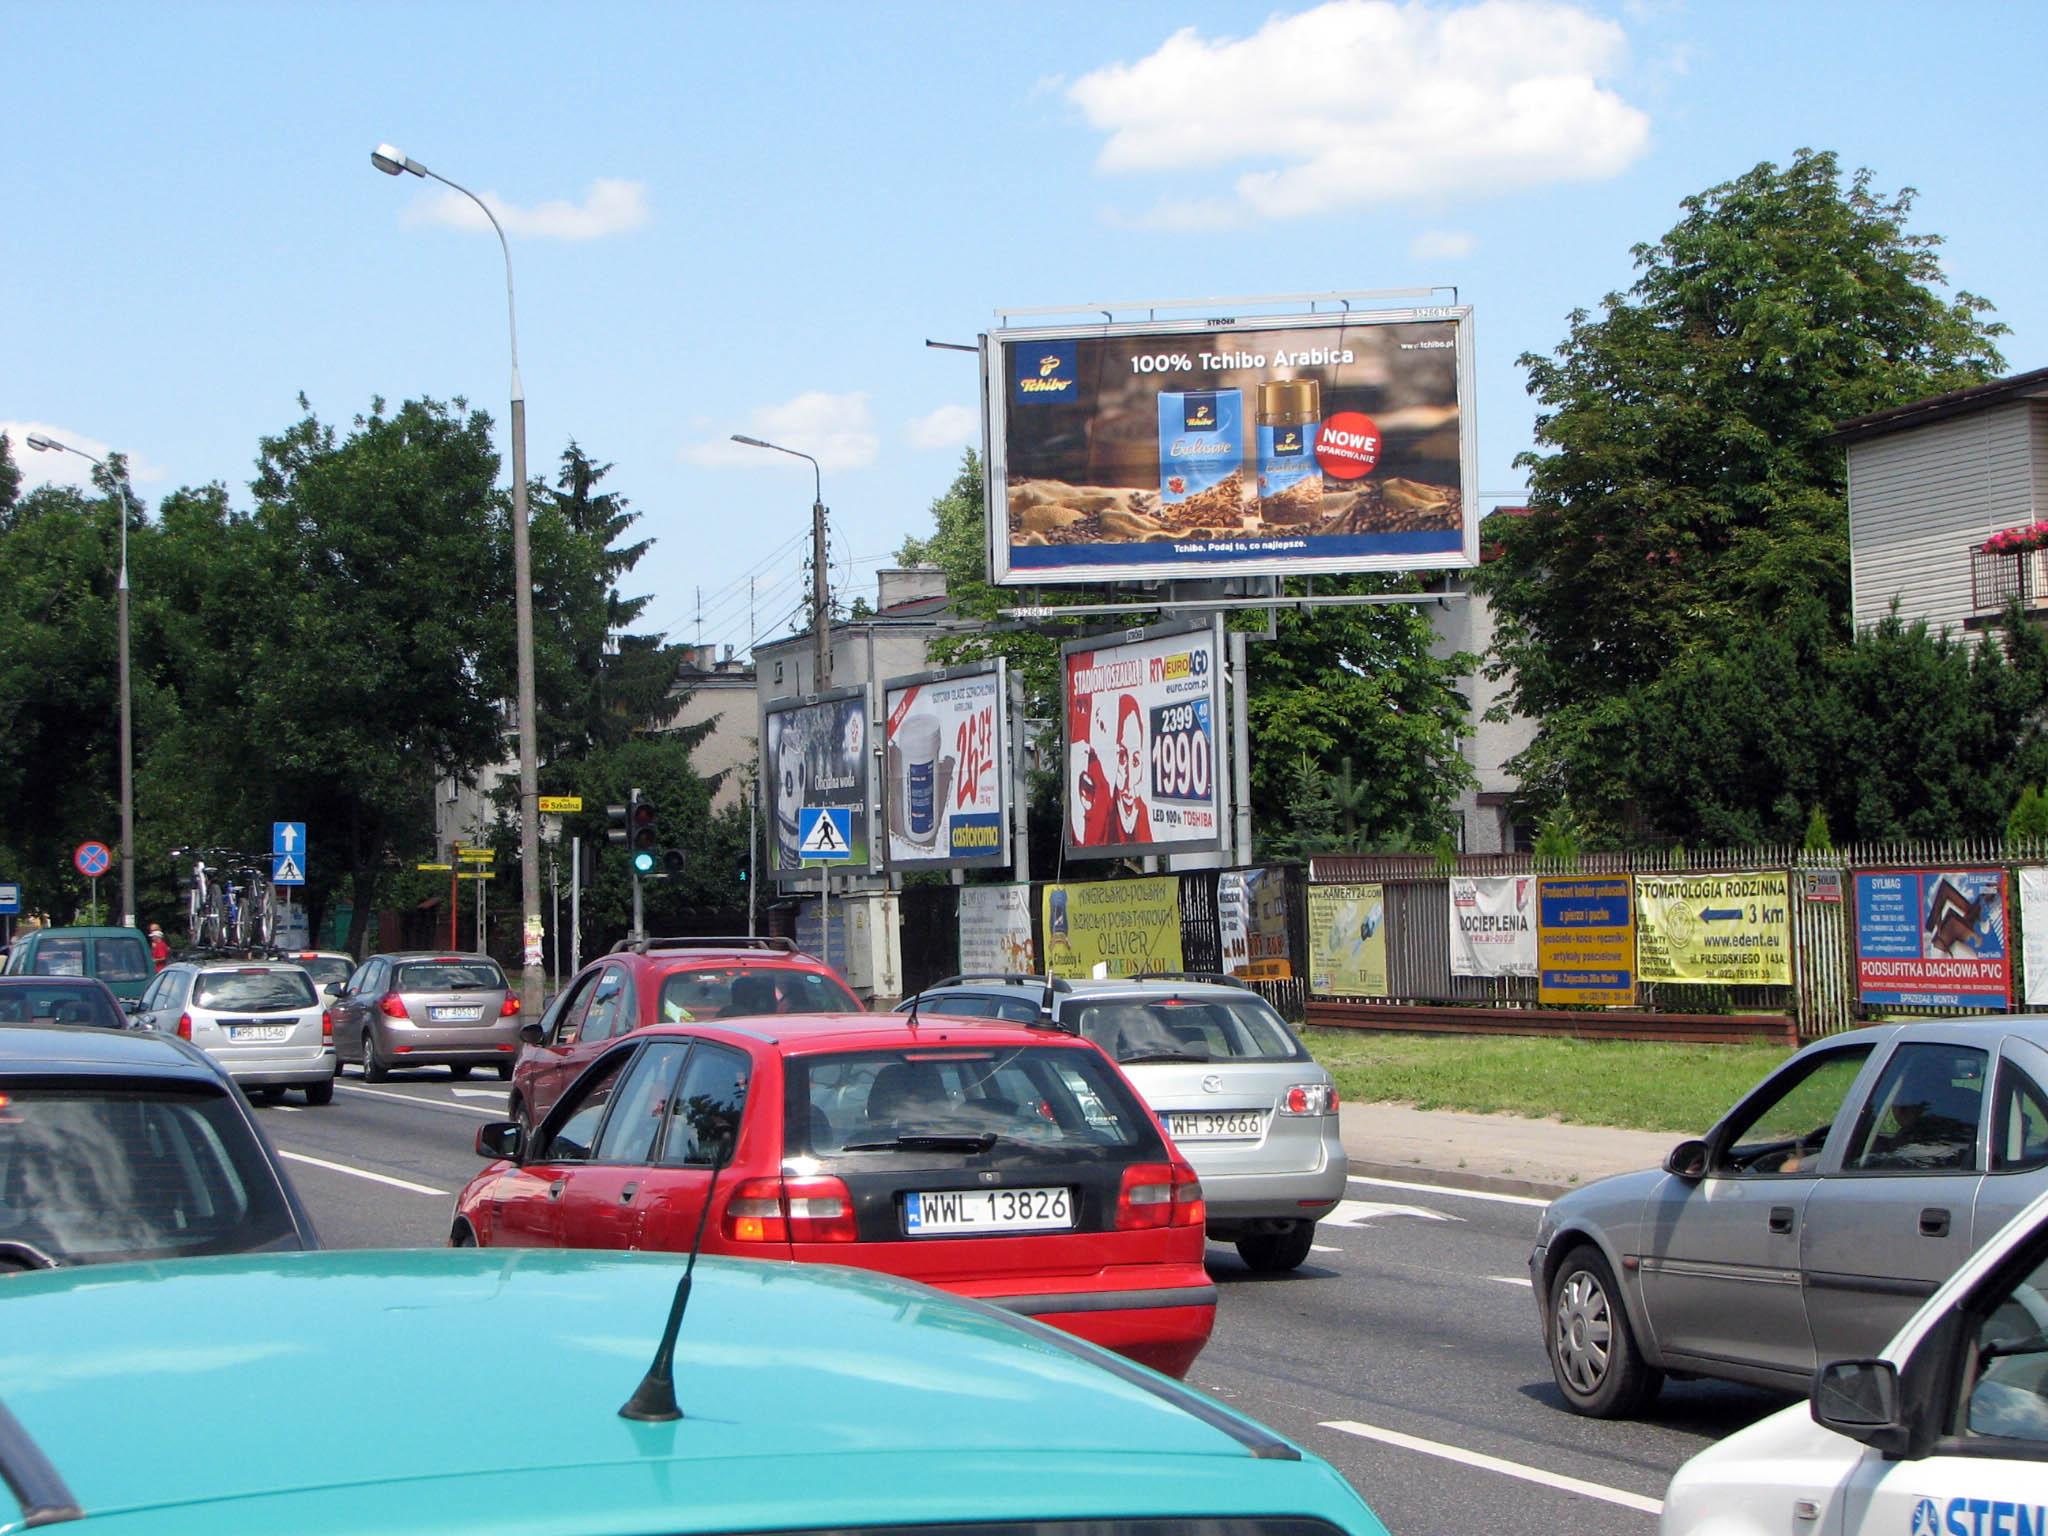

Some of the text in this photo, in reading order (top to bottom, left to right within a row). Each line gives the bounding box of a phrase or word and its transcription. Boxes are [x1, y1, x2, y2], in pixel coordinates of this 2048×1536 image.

[1131, 347, 1354, 374] 100% Tchibo Arabica
[1020, 379, 1072, 393] Tchibo
[1323, 428, 1377, 452] NOWE
[1316, 444, 1376, 464] OPAKOWANIE
[1174, 544, 1206, 553] Tchibo.
[1208, 542, 1233, 552] Podaj
[1235, 542, 1247, 551] to,
[1262, 540, 1307, 551] najlepsze.
[1150, 650, 1208, 683] RTV EURO AGD
[1166, 676, 1209, 694] euro.com.pl
[1162, 705, 1193, 732] 2399
[1152, 809, 1164, 822] LED
[1183, 811, 1213, 827] TOSHIBA
[952, 824, 998, 847] castorama
[1636, 880, 1785, 898] STOMATOLOGIA RODZINNA
[1872, 878, 1901, 889] SYLMAG
[1749, 904, 1784, 924] 3 km
[1704, 932, 1779, 947] www.edent.eu
[1861, 961, 2002, 978] PODSUFITKA DACHOWA PVC
[1172, 1113, 1258, 1134] WH 39666
[922, 1189, 1067, 1224] WWL 13826
